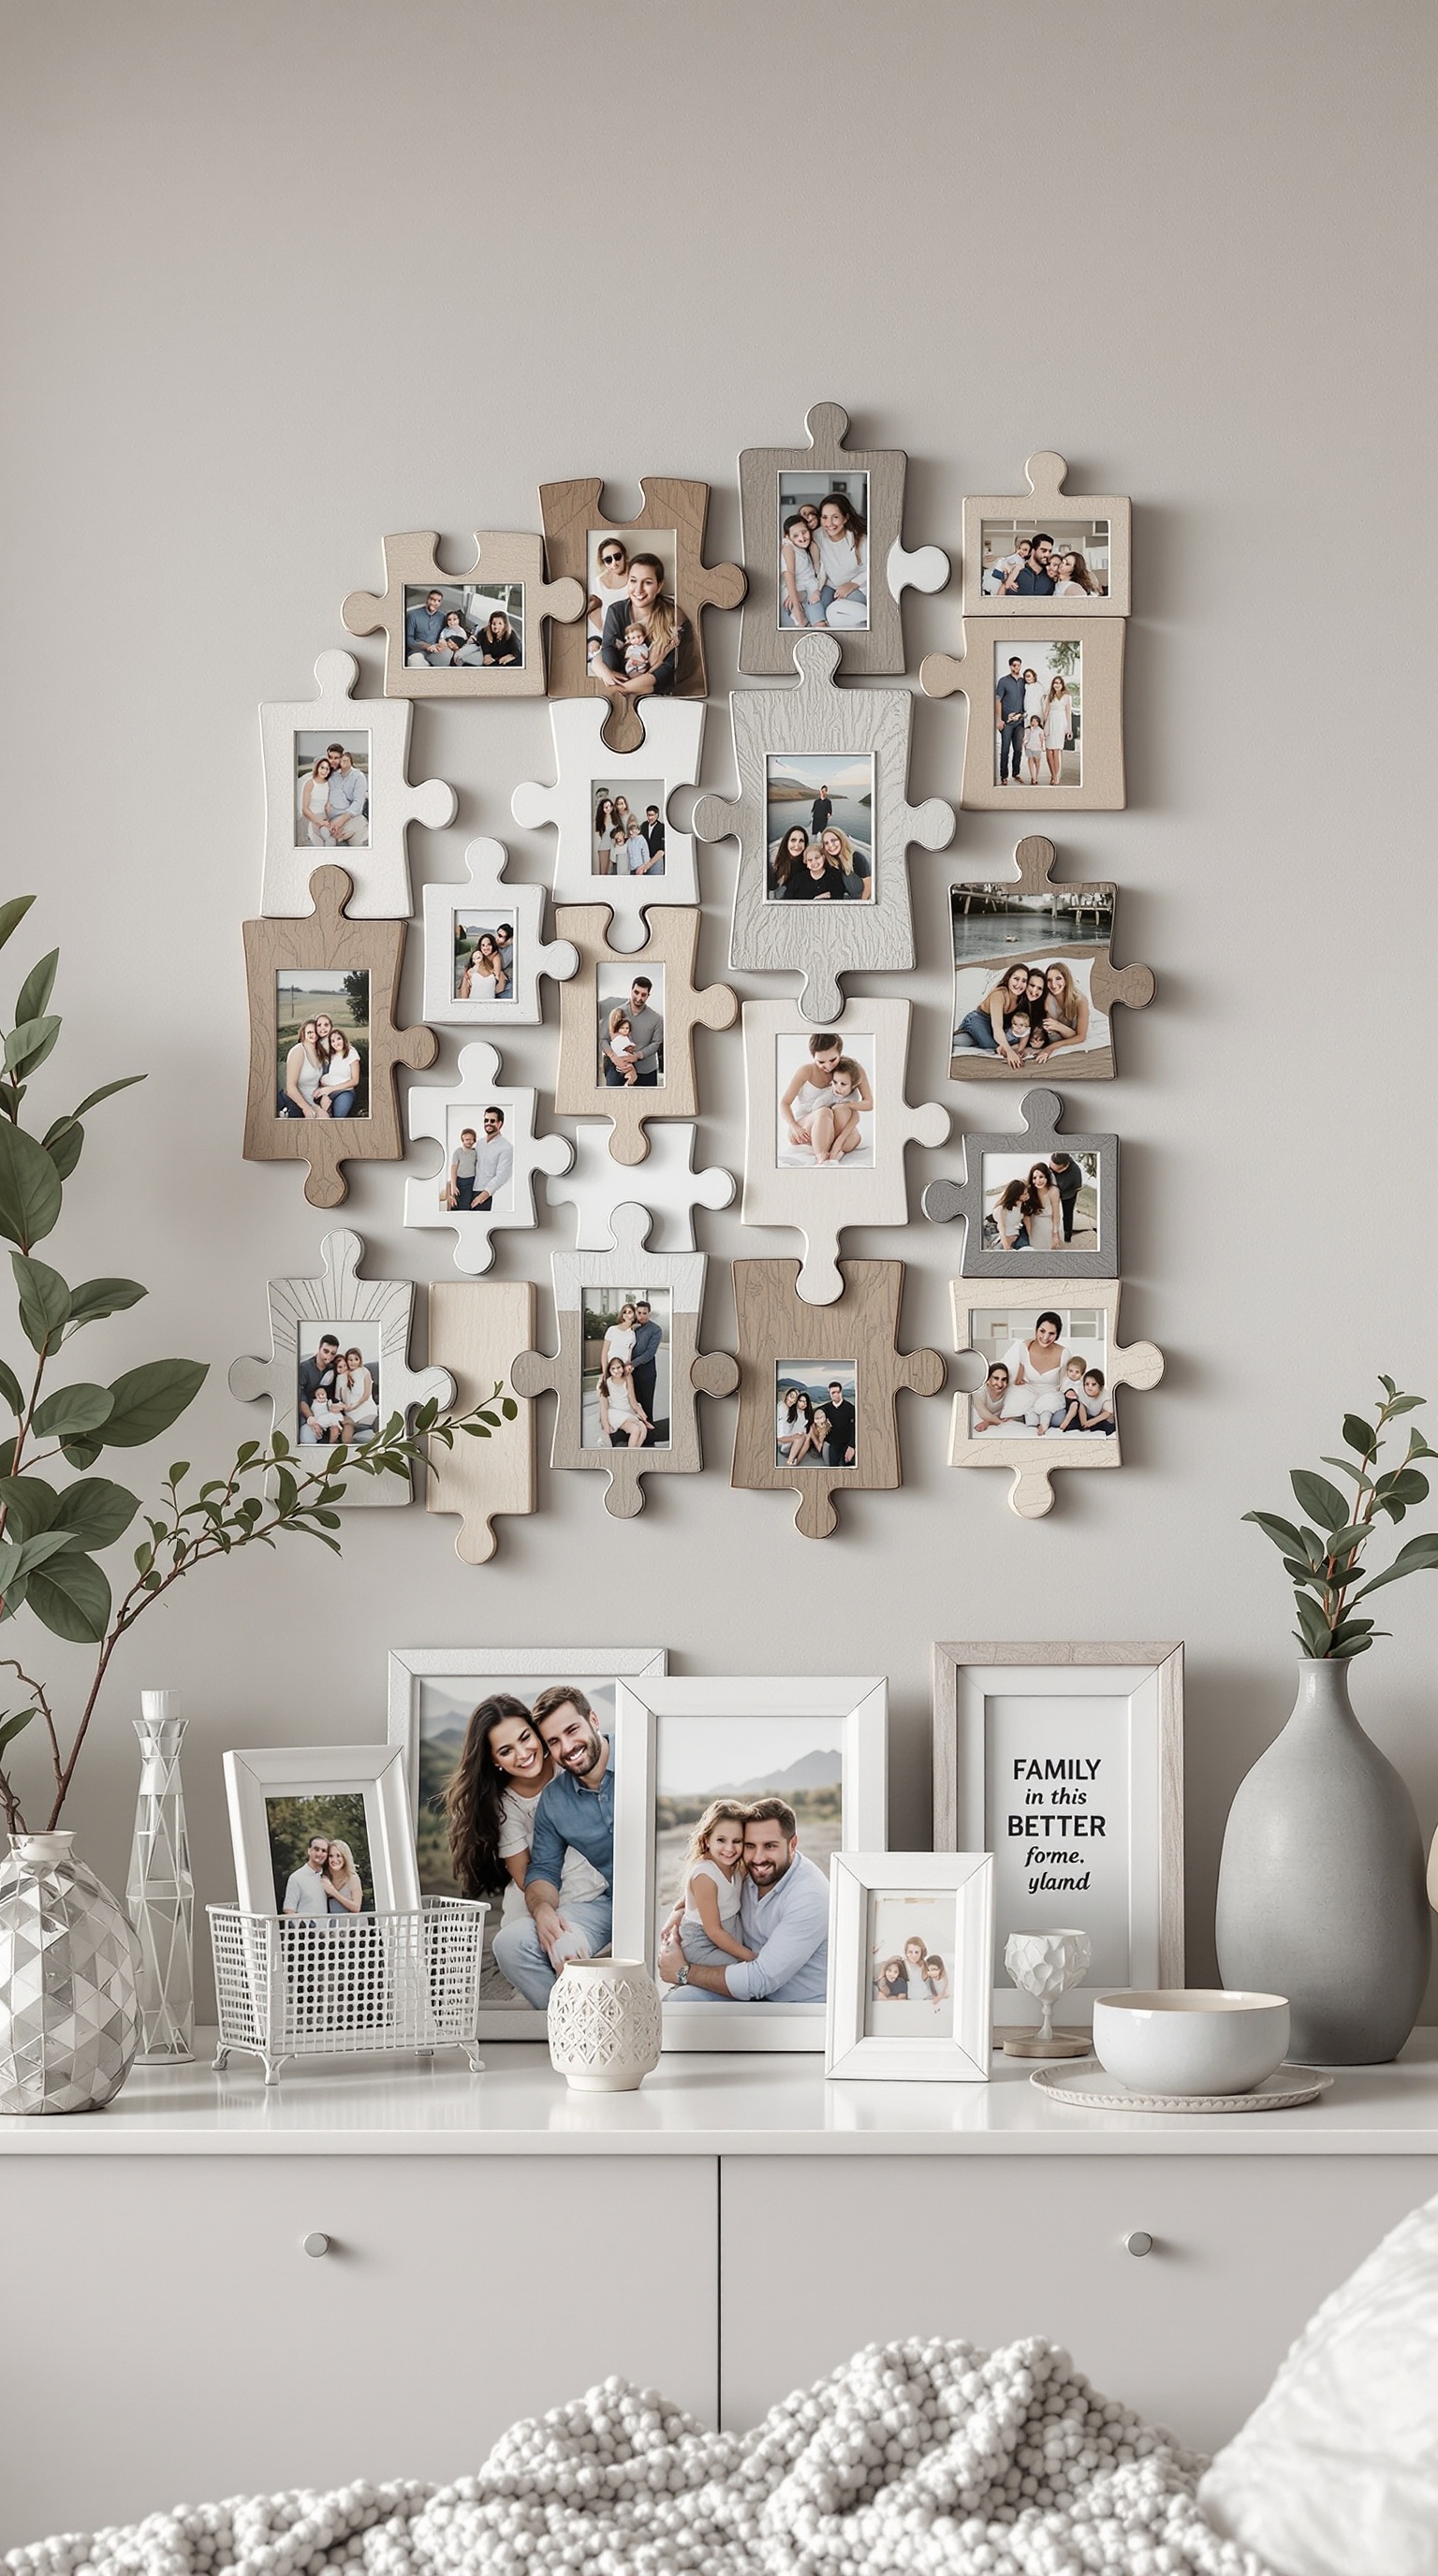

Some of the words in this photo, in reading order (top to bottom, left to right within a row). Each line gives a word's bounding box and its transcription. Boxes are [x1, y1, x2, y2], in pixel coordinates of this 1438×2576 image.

[1013, 1759, 1102, 1780] FAMILY
[1025, 1789, 1045, 1805] in
[1050, 1787, 1087, 1805] this
[1007, 1815, 1107, 1837] BETTER
